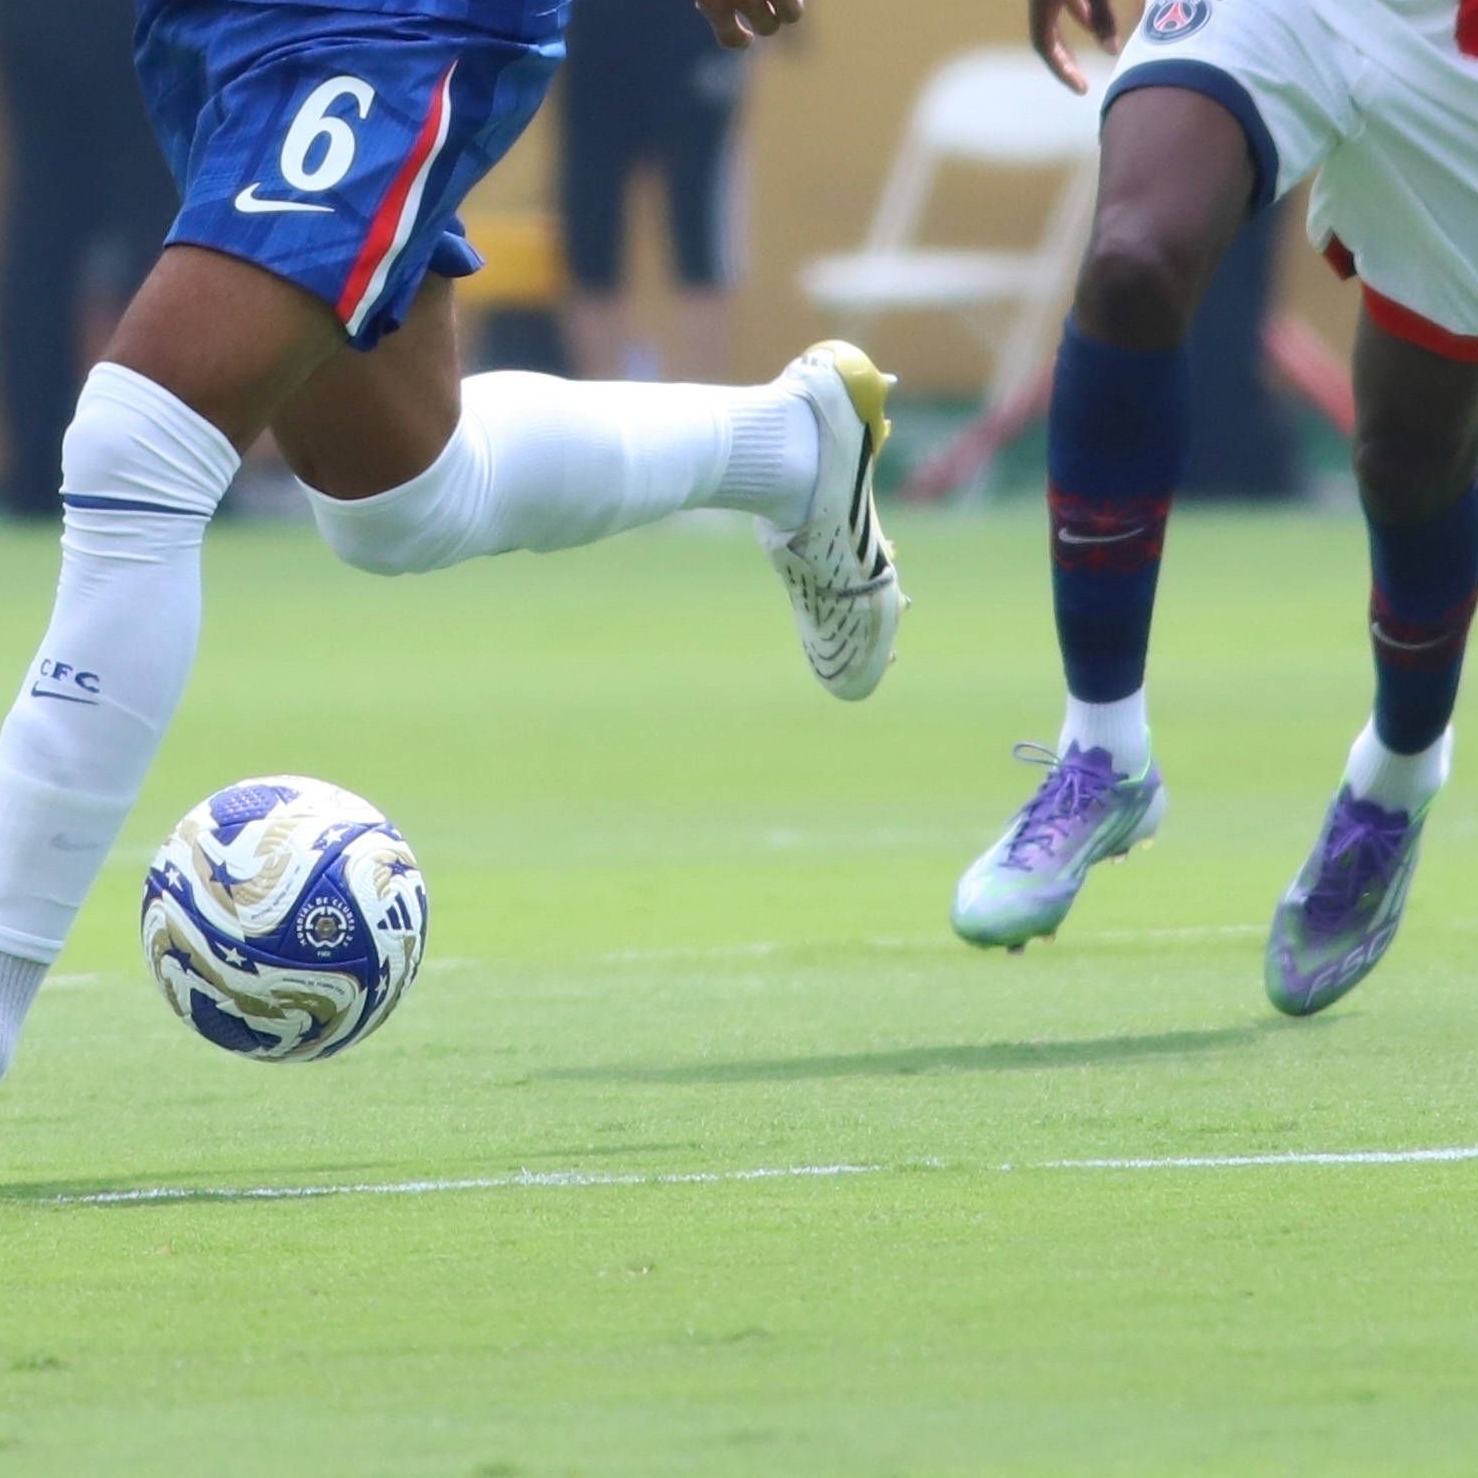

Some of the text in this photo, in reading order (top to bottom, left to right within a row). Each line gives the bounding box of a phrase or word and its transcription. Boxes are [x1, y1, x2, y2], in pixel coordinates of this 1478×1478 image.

[280, 75, 376, 192] 6
[40, 658, 100, 694] CFC
[315, 896, 329, 906] DE
